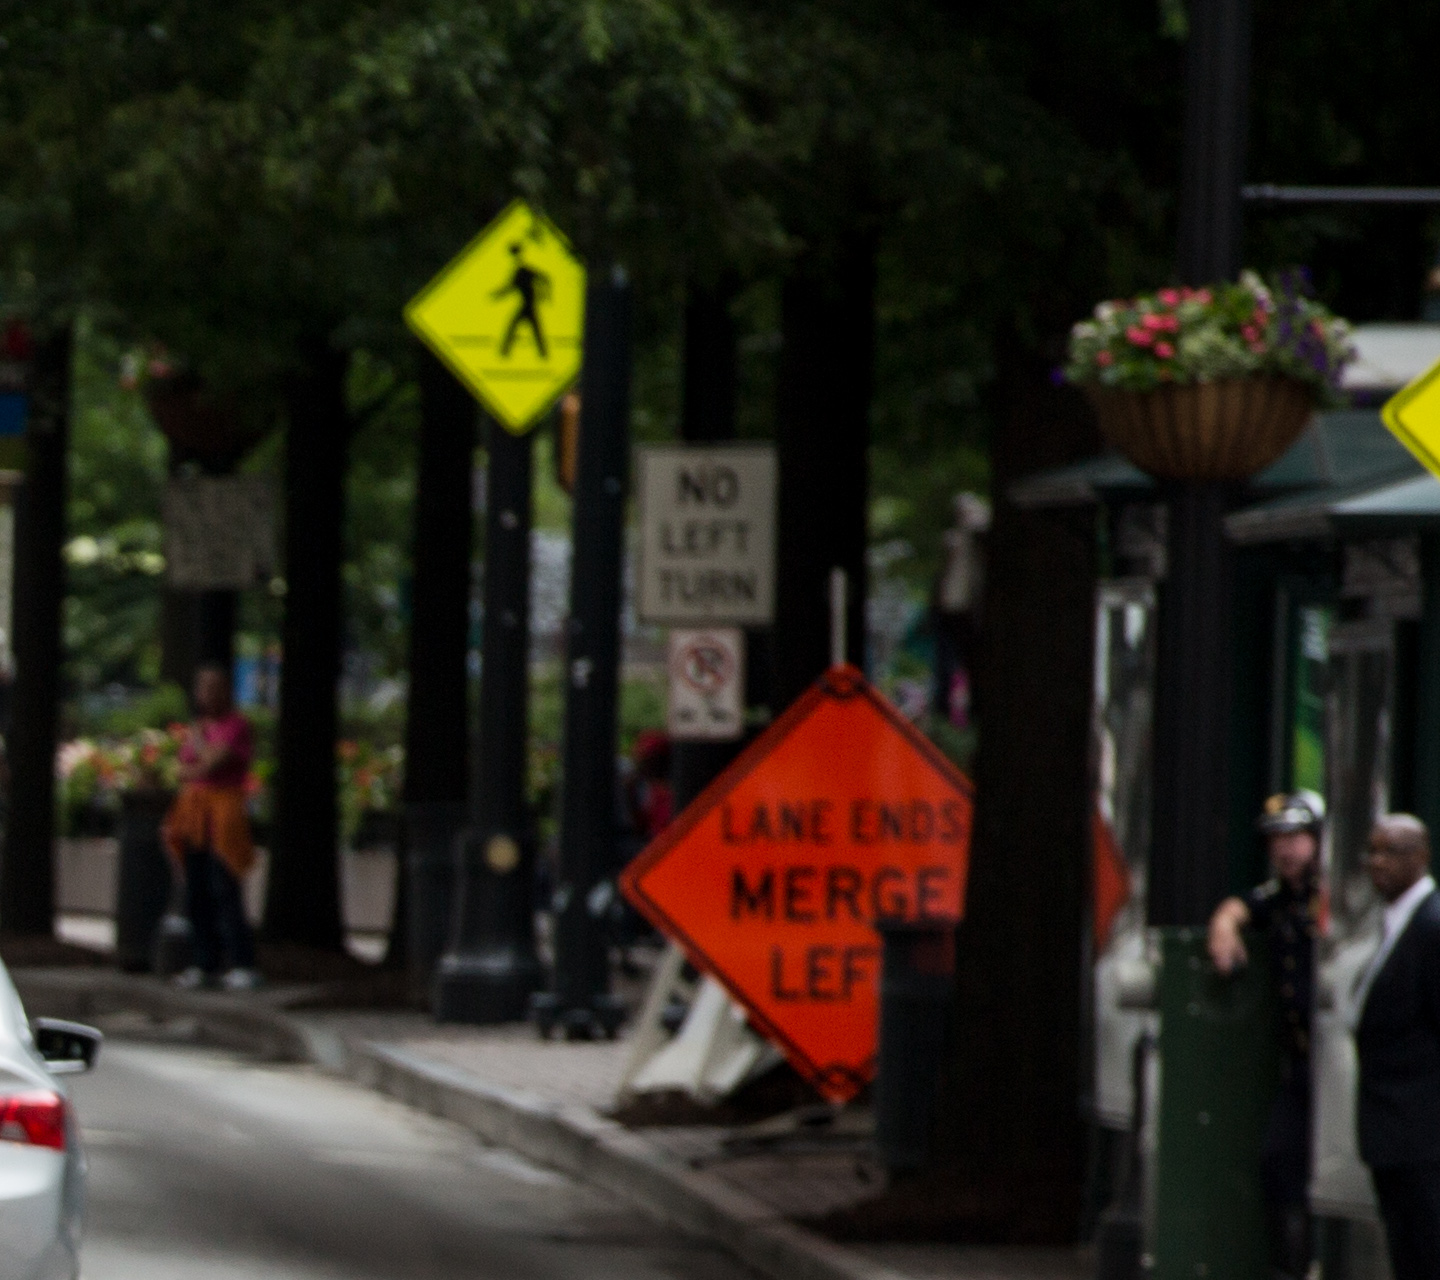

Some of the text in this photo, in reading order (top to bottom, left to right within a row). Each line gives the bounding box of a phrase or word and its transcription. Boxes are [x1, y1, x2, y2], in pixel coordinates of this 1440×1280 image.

[677, 464, 740, 508] NO
[659, 517, 751, 556] LEFT
[657, 567, 758, 604] TURN
[720, 797, 967, 847] LANE ENDS
[730, 863, 952, 925] MERGE
[769, 941, 883, 1004] LEF
